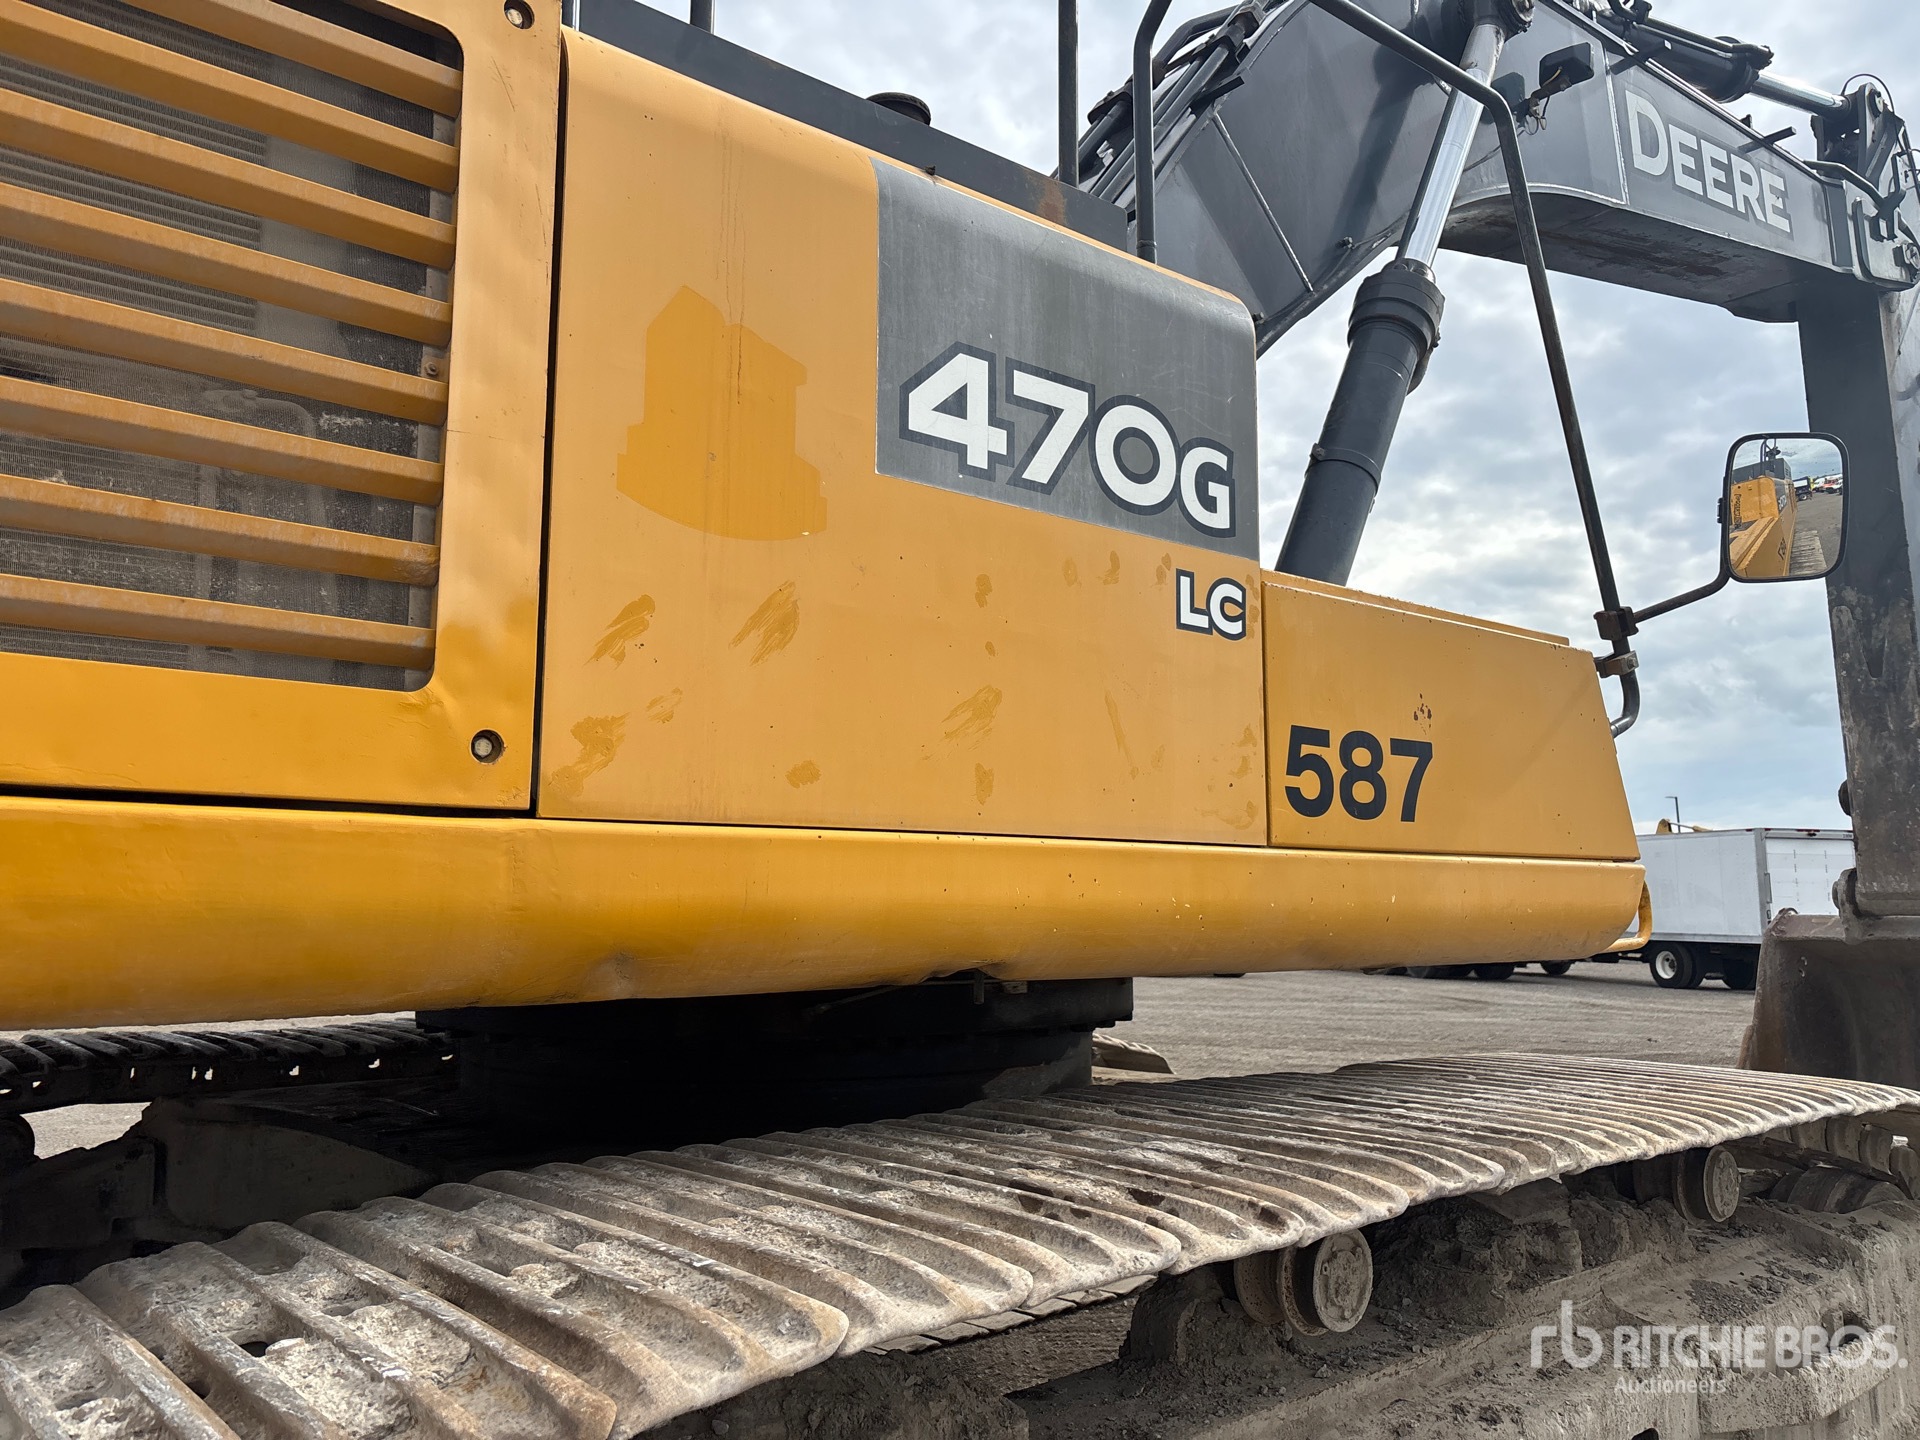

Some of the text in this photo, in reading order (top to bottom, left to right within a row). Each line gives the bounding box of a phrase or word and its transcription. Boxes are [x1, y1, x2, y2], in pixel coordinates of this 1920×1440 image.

[1625, 89, 1790, 233] DEERE
[905, 348, 1233, 532] 470G
[1178, 572, 1245, 638] LC
[1284, 724, 1434, 823] 587
